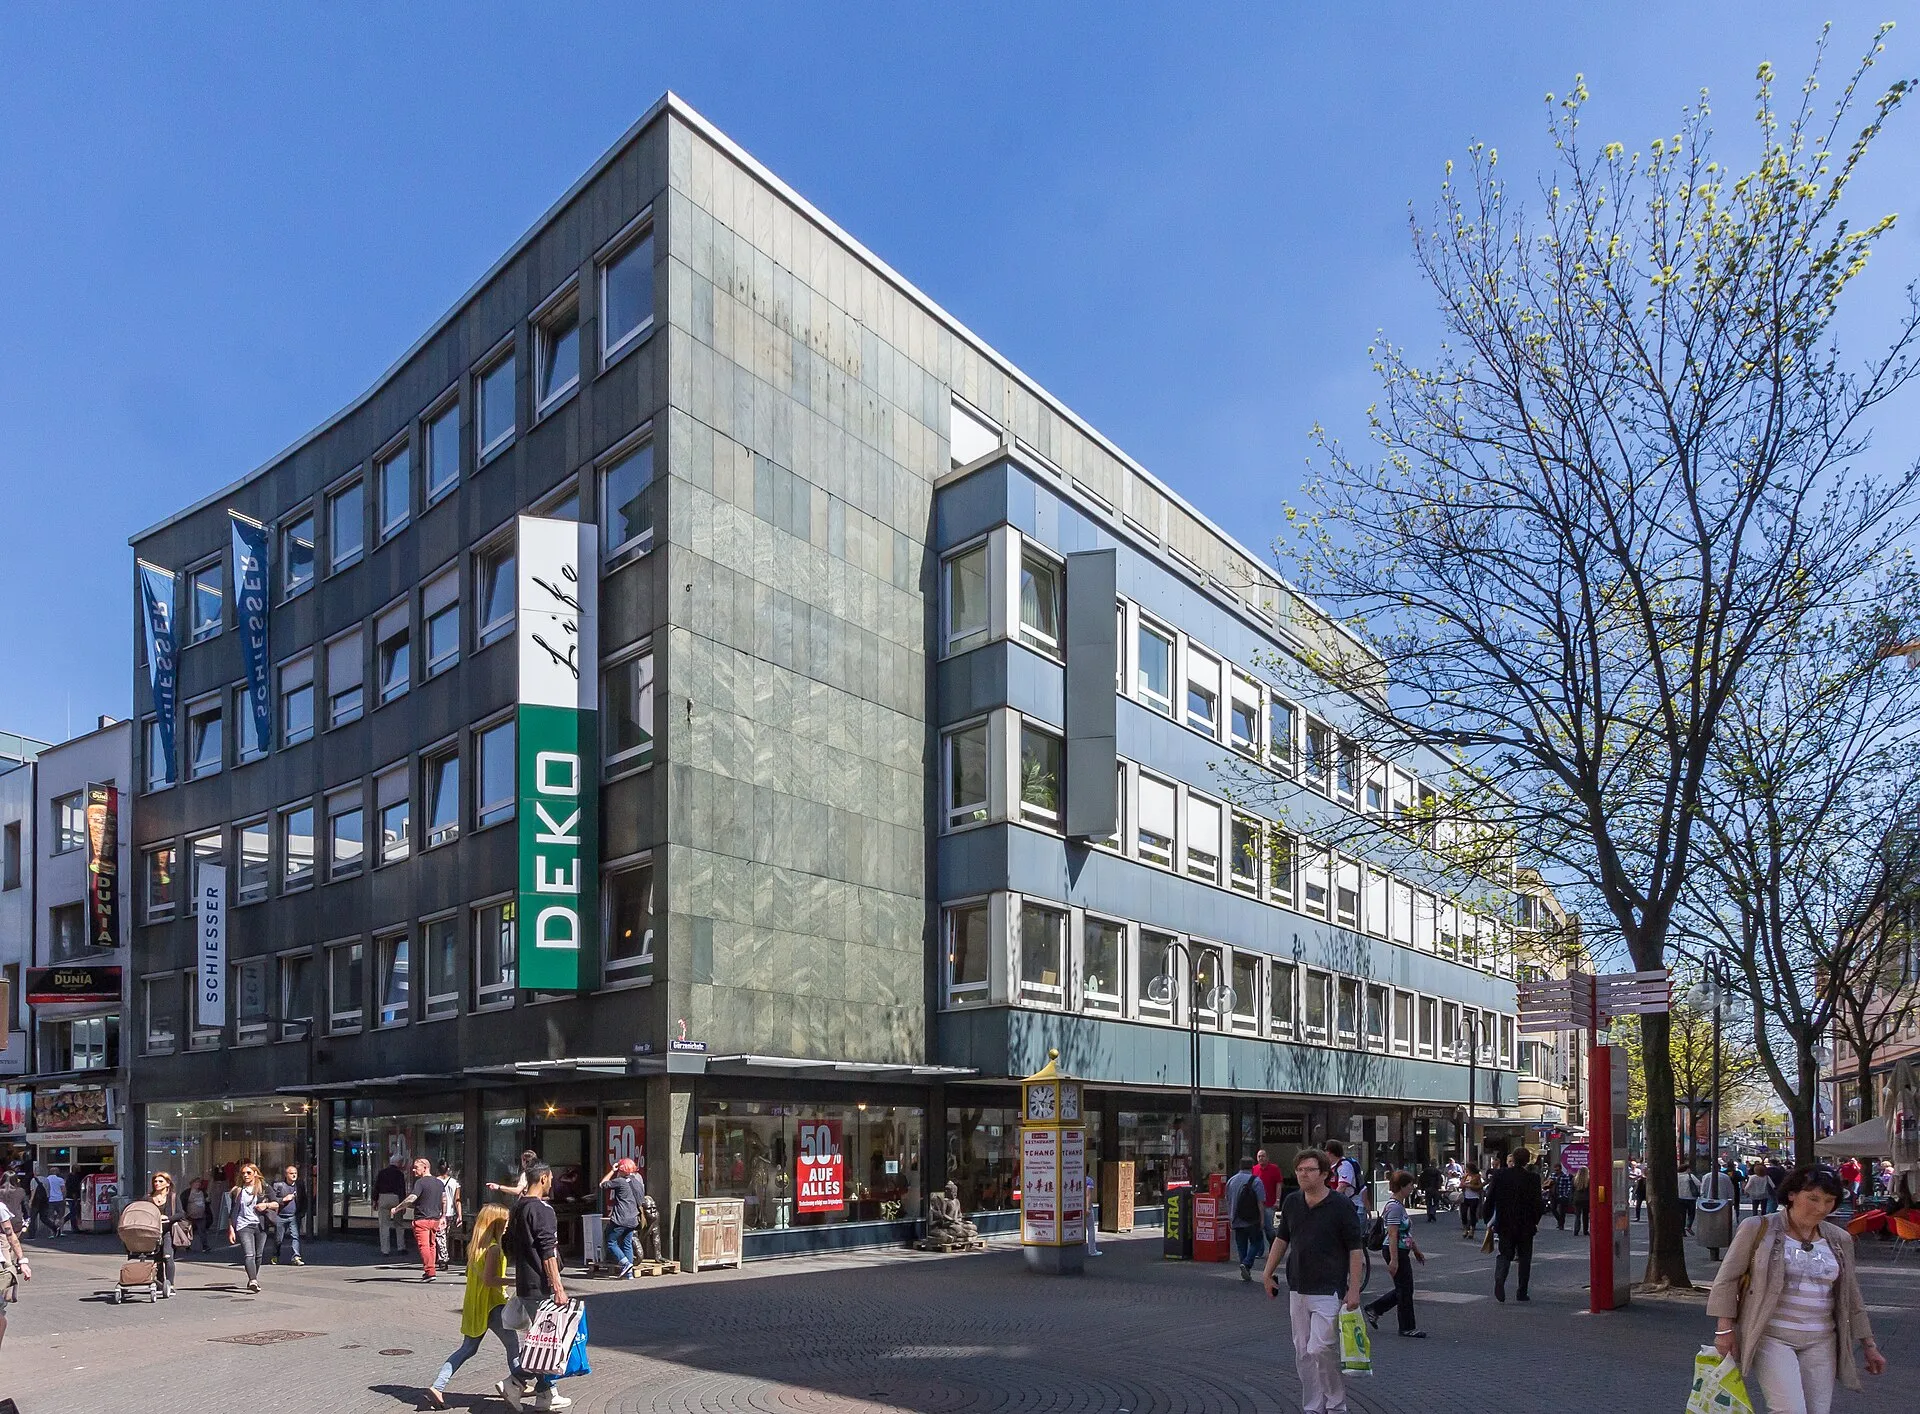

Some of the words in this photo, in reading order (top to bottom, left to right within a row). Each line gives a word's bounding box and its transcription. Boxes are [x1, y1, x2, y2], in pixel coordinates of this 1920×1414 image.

[532, 563, 584, 680] Life
[535, 751, 581, 949] DEKO
[97, 876, 112, 941] DUNIA
[205, 887, 219, 1003] SCHIESSER
[54, 974, 93, 985] DUNIA
[800, 1124, 841, 1165] 50%
[801, 1181, 840, 1196] ALLES
[809, 1168, 833, 1182] AUF
[1167, 1195, 1179, 1240] XTRA
